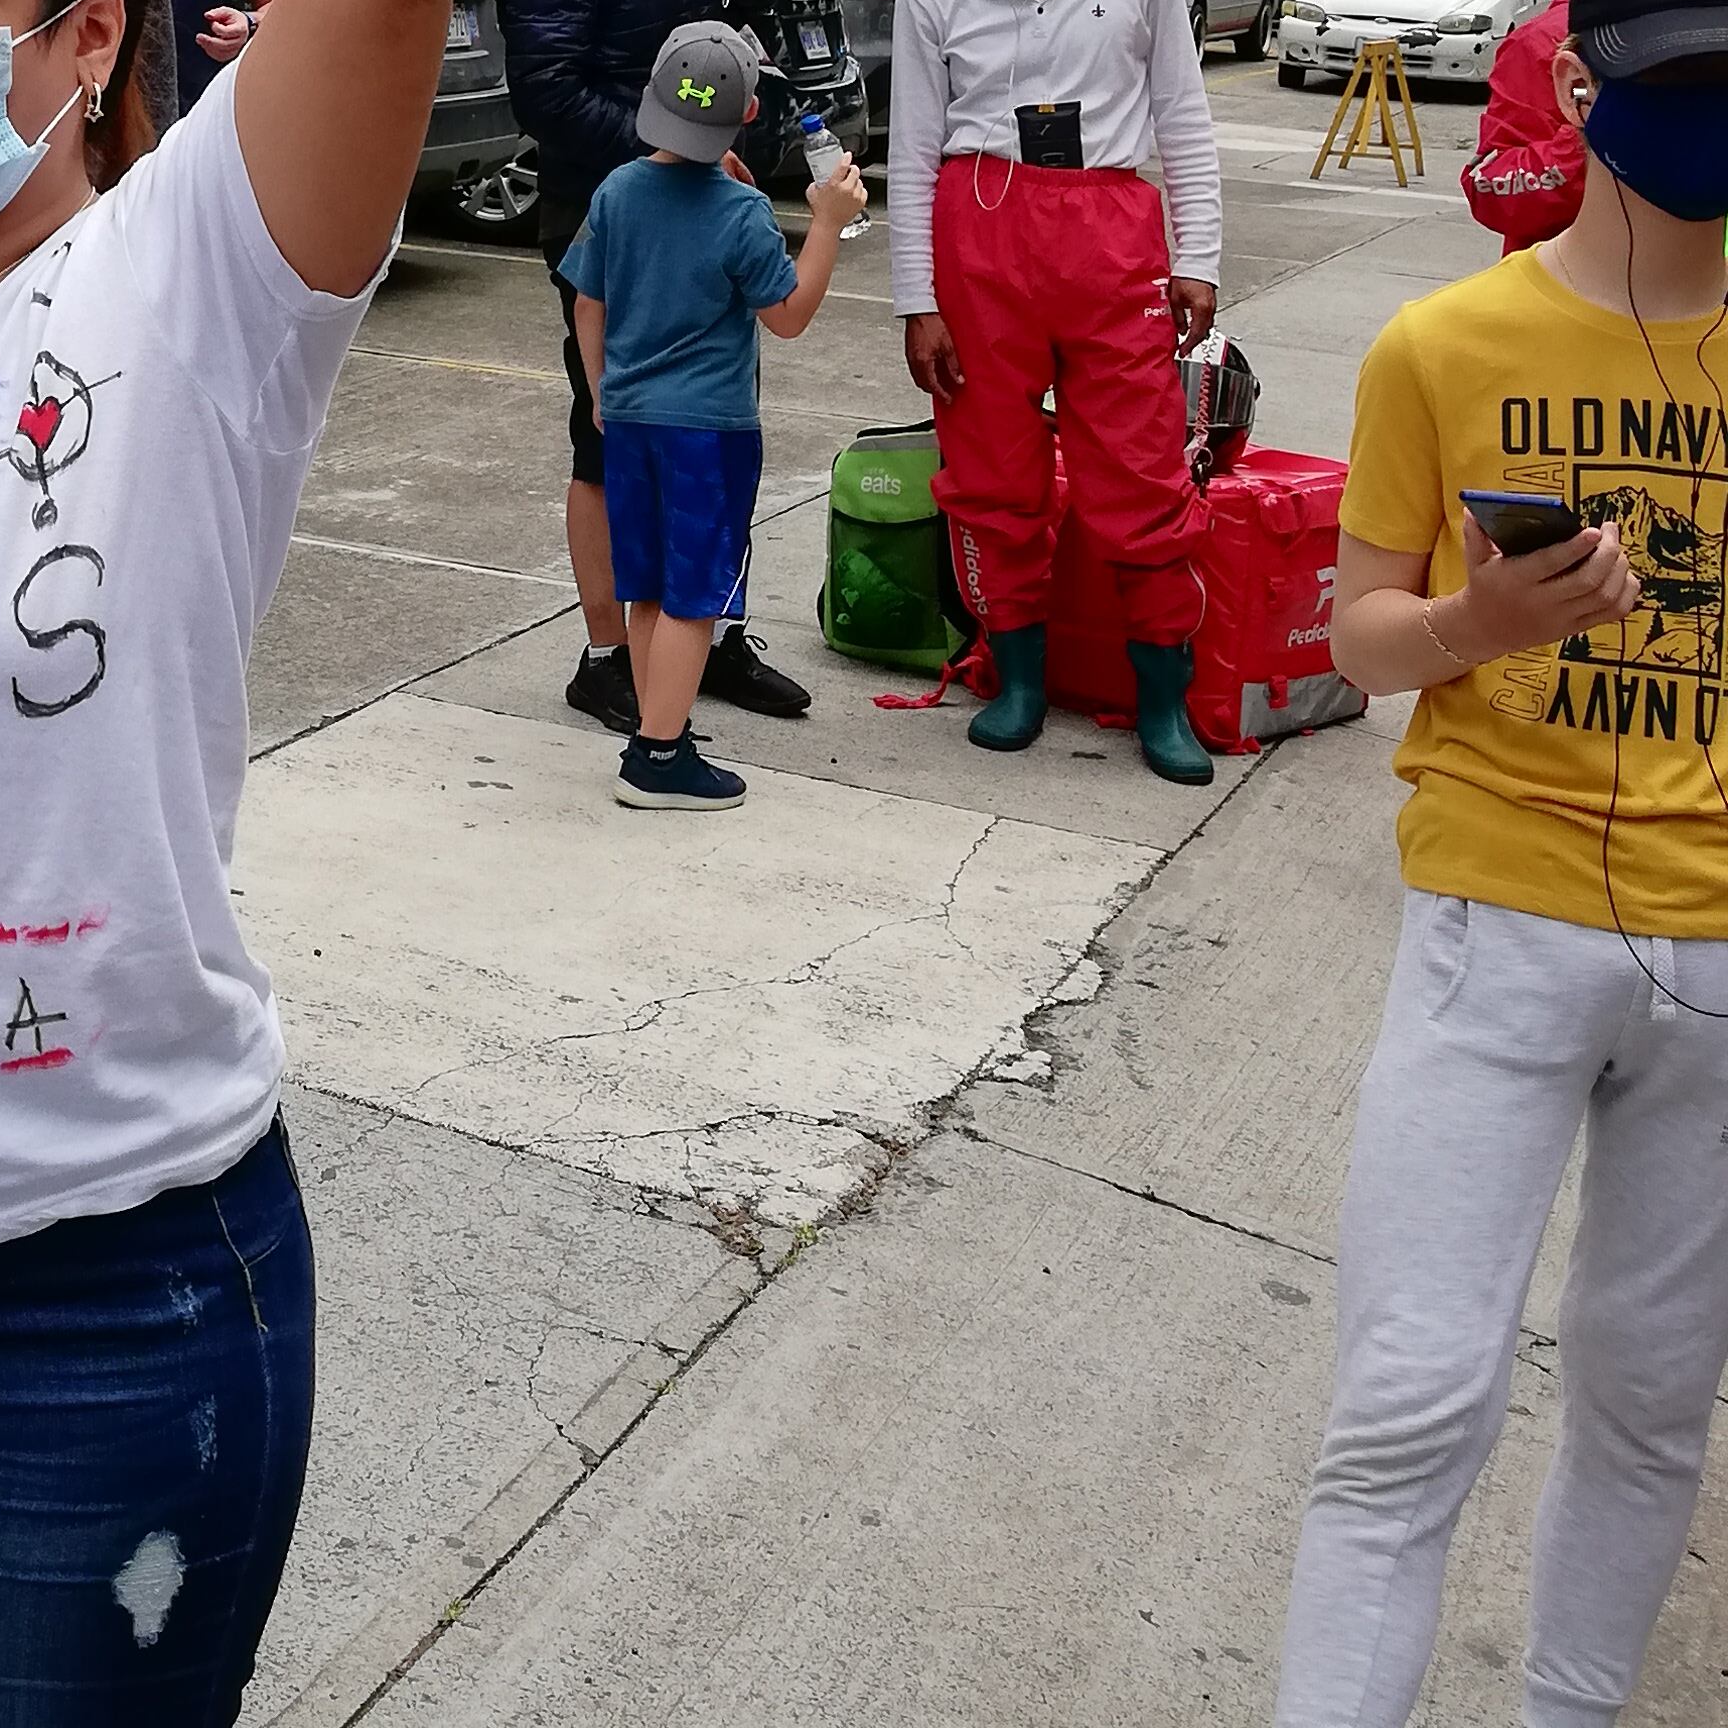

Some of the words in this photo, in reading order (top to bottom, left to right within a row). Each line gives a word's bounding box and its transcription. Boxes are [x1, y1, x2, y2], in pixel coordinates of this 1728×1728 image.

[1502, 397, 1603, 456] OLD
[860, 474, 902, 496] eats
[1545, 666, 1678, 742] NAVY
